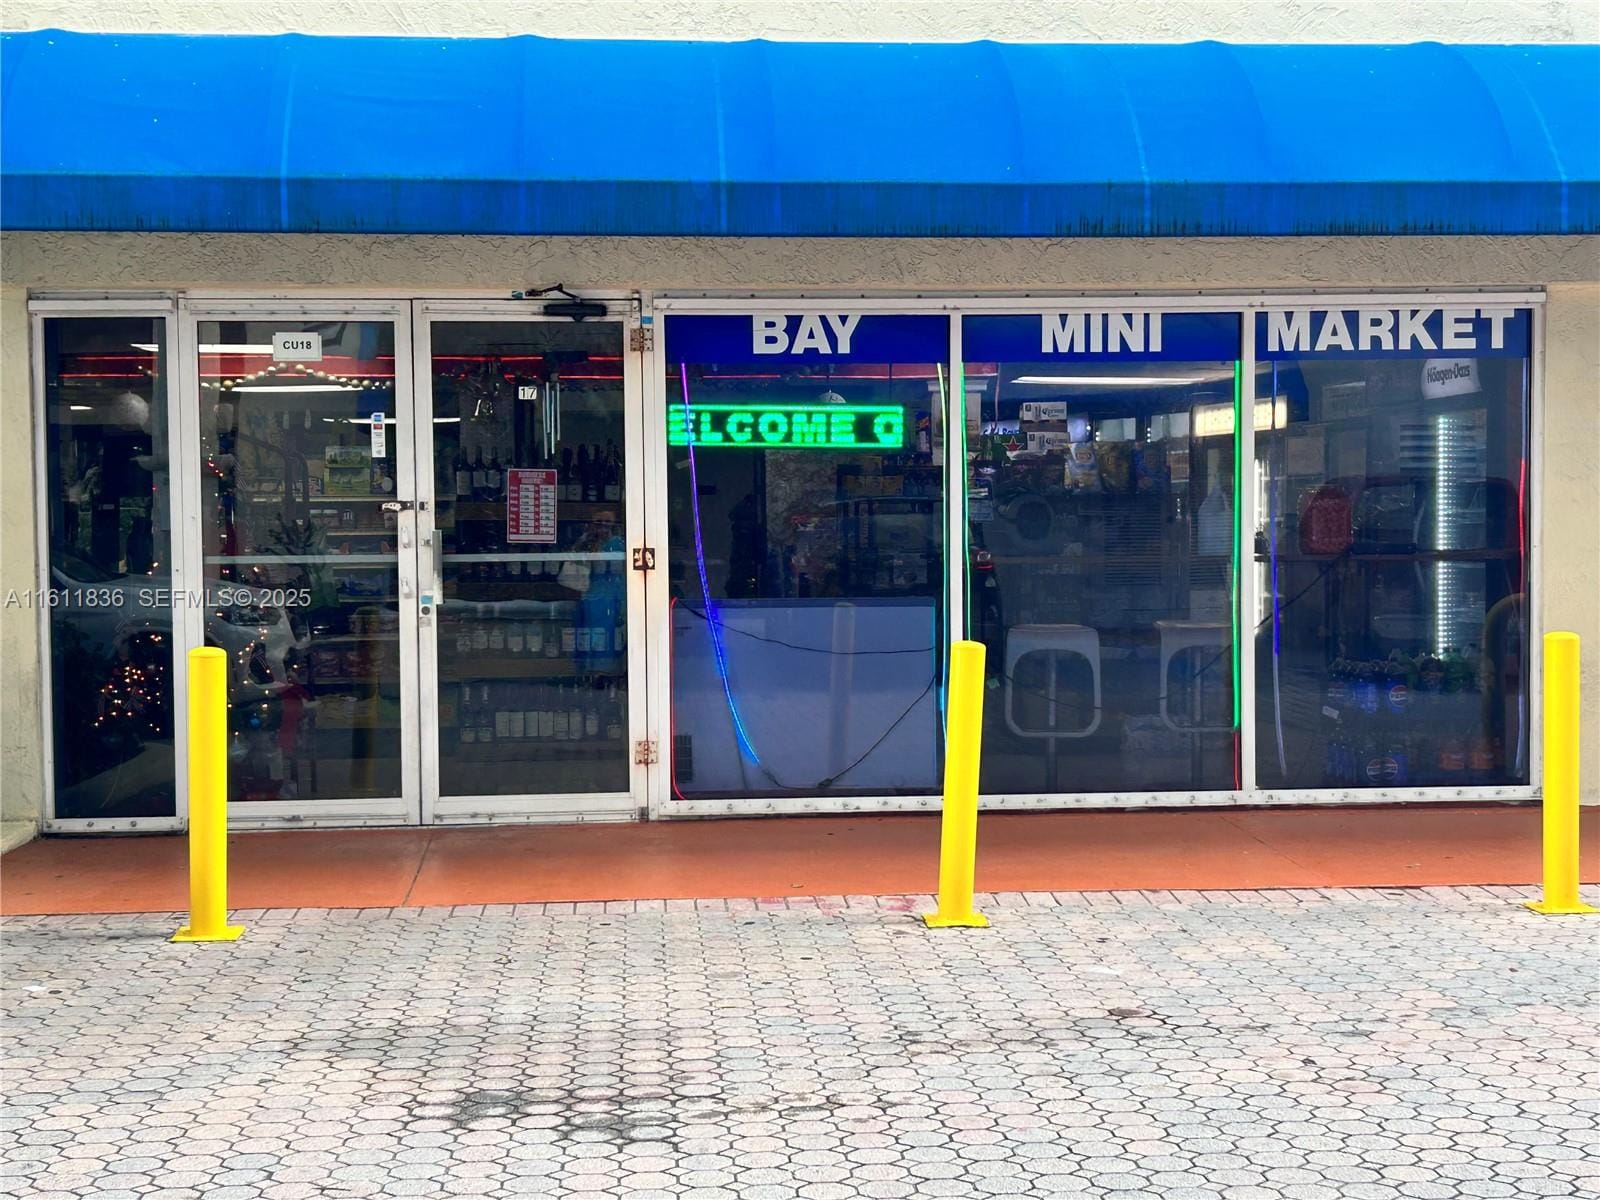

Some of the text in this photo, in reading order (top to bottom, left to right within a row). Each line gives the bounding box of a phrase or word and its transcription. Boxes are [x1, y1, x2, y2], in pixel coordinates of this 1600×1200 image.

[752, 308, 1515, 355] BAY MINI MARKET
[282, 340, 312, 350] CU18
[520, 387, 537, 399] 17
